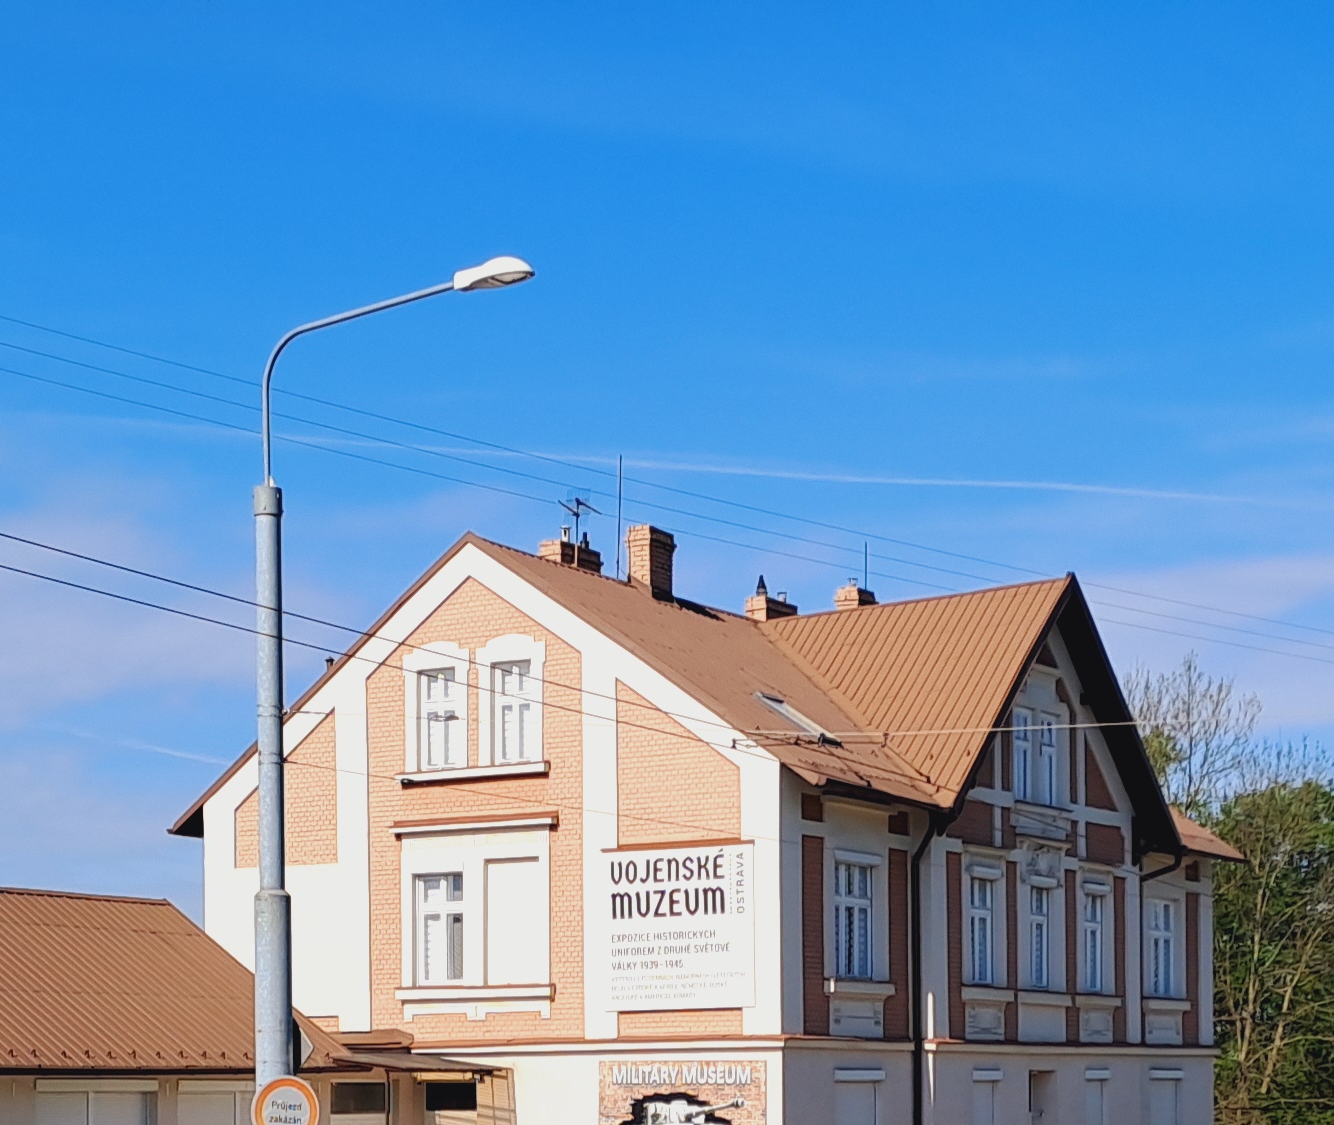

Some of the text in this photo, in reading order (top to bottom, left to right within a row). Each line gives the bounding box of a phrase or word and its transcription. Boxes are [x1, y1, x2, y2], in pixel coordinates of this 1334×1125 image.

[610, 848, 725, 886] VOJENSKÉ
[736, 852, 745, 914] OSTRAVA
[611, 886, 725, 920] MUZEUM
[611, 933, 651, 943] EXPOZICE
[657, 946, 662, 955] Z
[664, 942, 691, 954] DRUHÉ
[694, 942, 730, 954] SVĚTOVÉ
[612, 961, 638, 971] VÁLKY
[612, 1064, 752, 1085] MILITARY MUSEUM
[271, 1101, 302, 1112] Průjezd
[269, 1114, 302, 1125] zakázán
